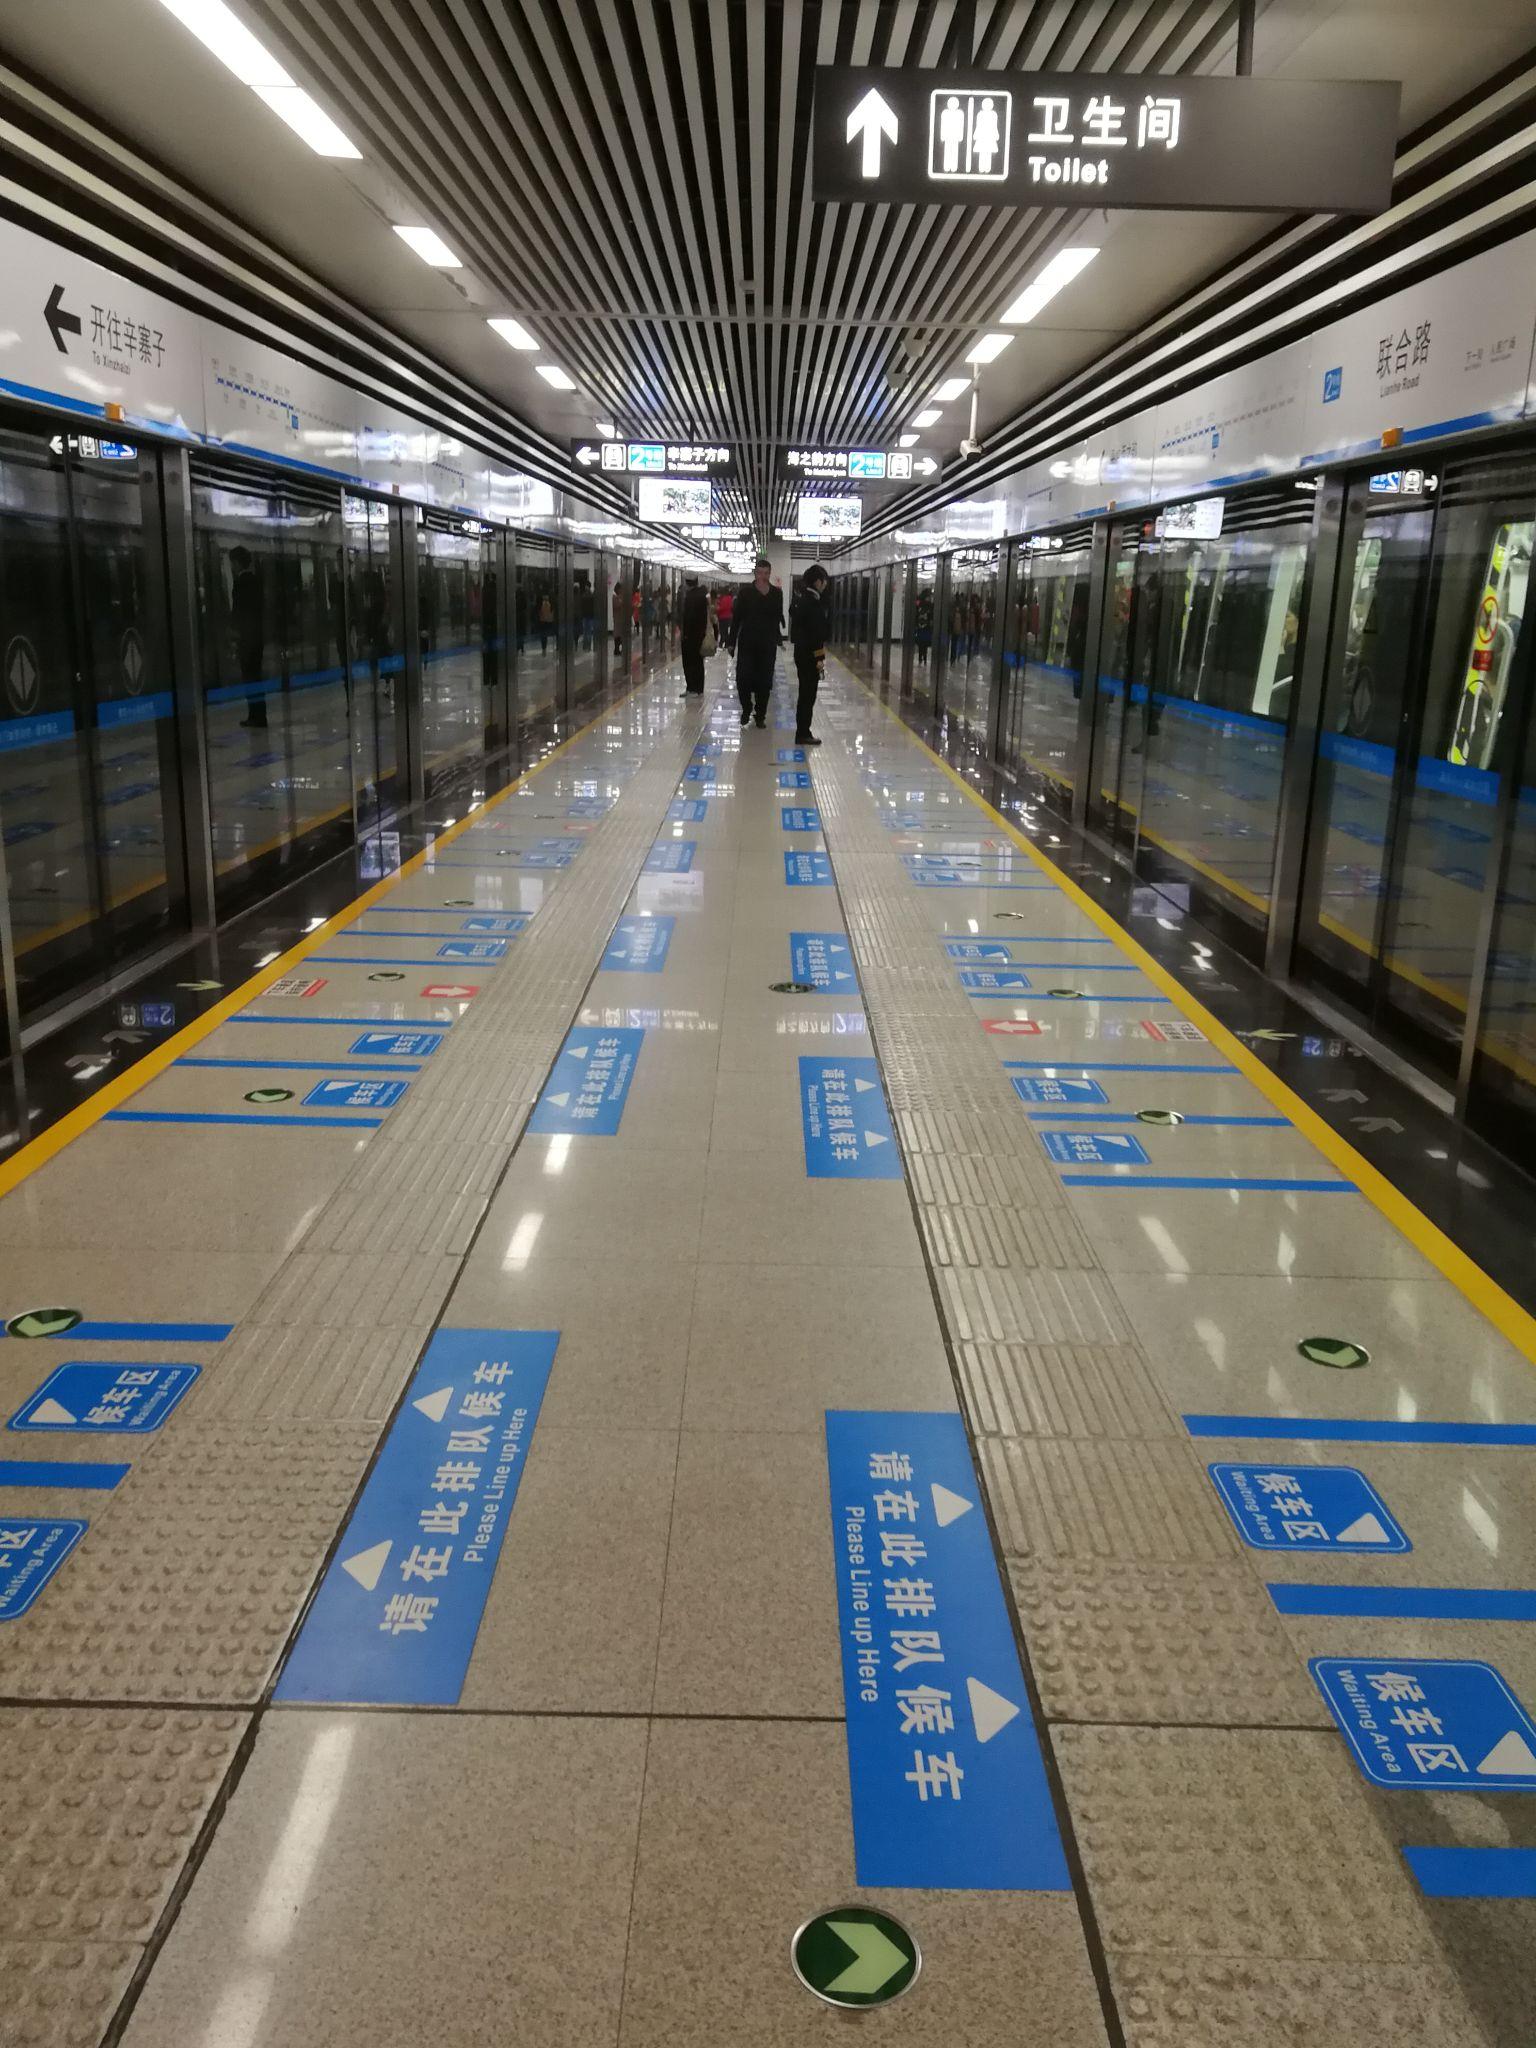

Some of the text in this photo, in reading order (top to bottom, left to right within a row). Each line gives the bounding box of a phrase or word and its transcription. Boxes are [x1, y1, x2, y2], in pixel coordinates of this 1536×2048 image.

[1028, 95, 1181, 149] 卫生间
[1028, 156, 1108, 184] Toilet
[90, 304, 165, 368] 开往辛寨子
[1376, 320, 1431, 379] 联合路
[1402, 374, 1420, 390] Road
[571, 1038, 621, 1118] 请在此排队候车
[822, 1069, 860, 1160] 请在此排队候车
[82, 1370, 159, 1423] 候车区
[129, 1370, 181, 1426] Waiting Area
[380, 1360, 513, 1634] 请在此排队候车
[463, 1408, 527, 1562] Please Line up Here
[1231, 1471, 1276, 1540] Waiting Area
[1254, 1473, 1330, 1541] 候车区
[32, 1528, 64, 1558] Area
[846, 1506, 880, 1702] Please Line up Here
[869, 1451, 964, 1800] 请在此排队候车
[1337, 1669, 1401, 1772] Waiting Area
[1365, 1671, 1469, 1773] 候车区
